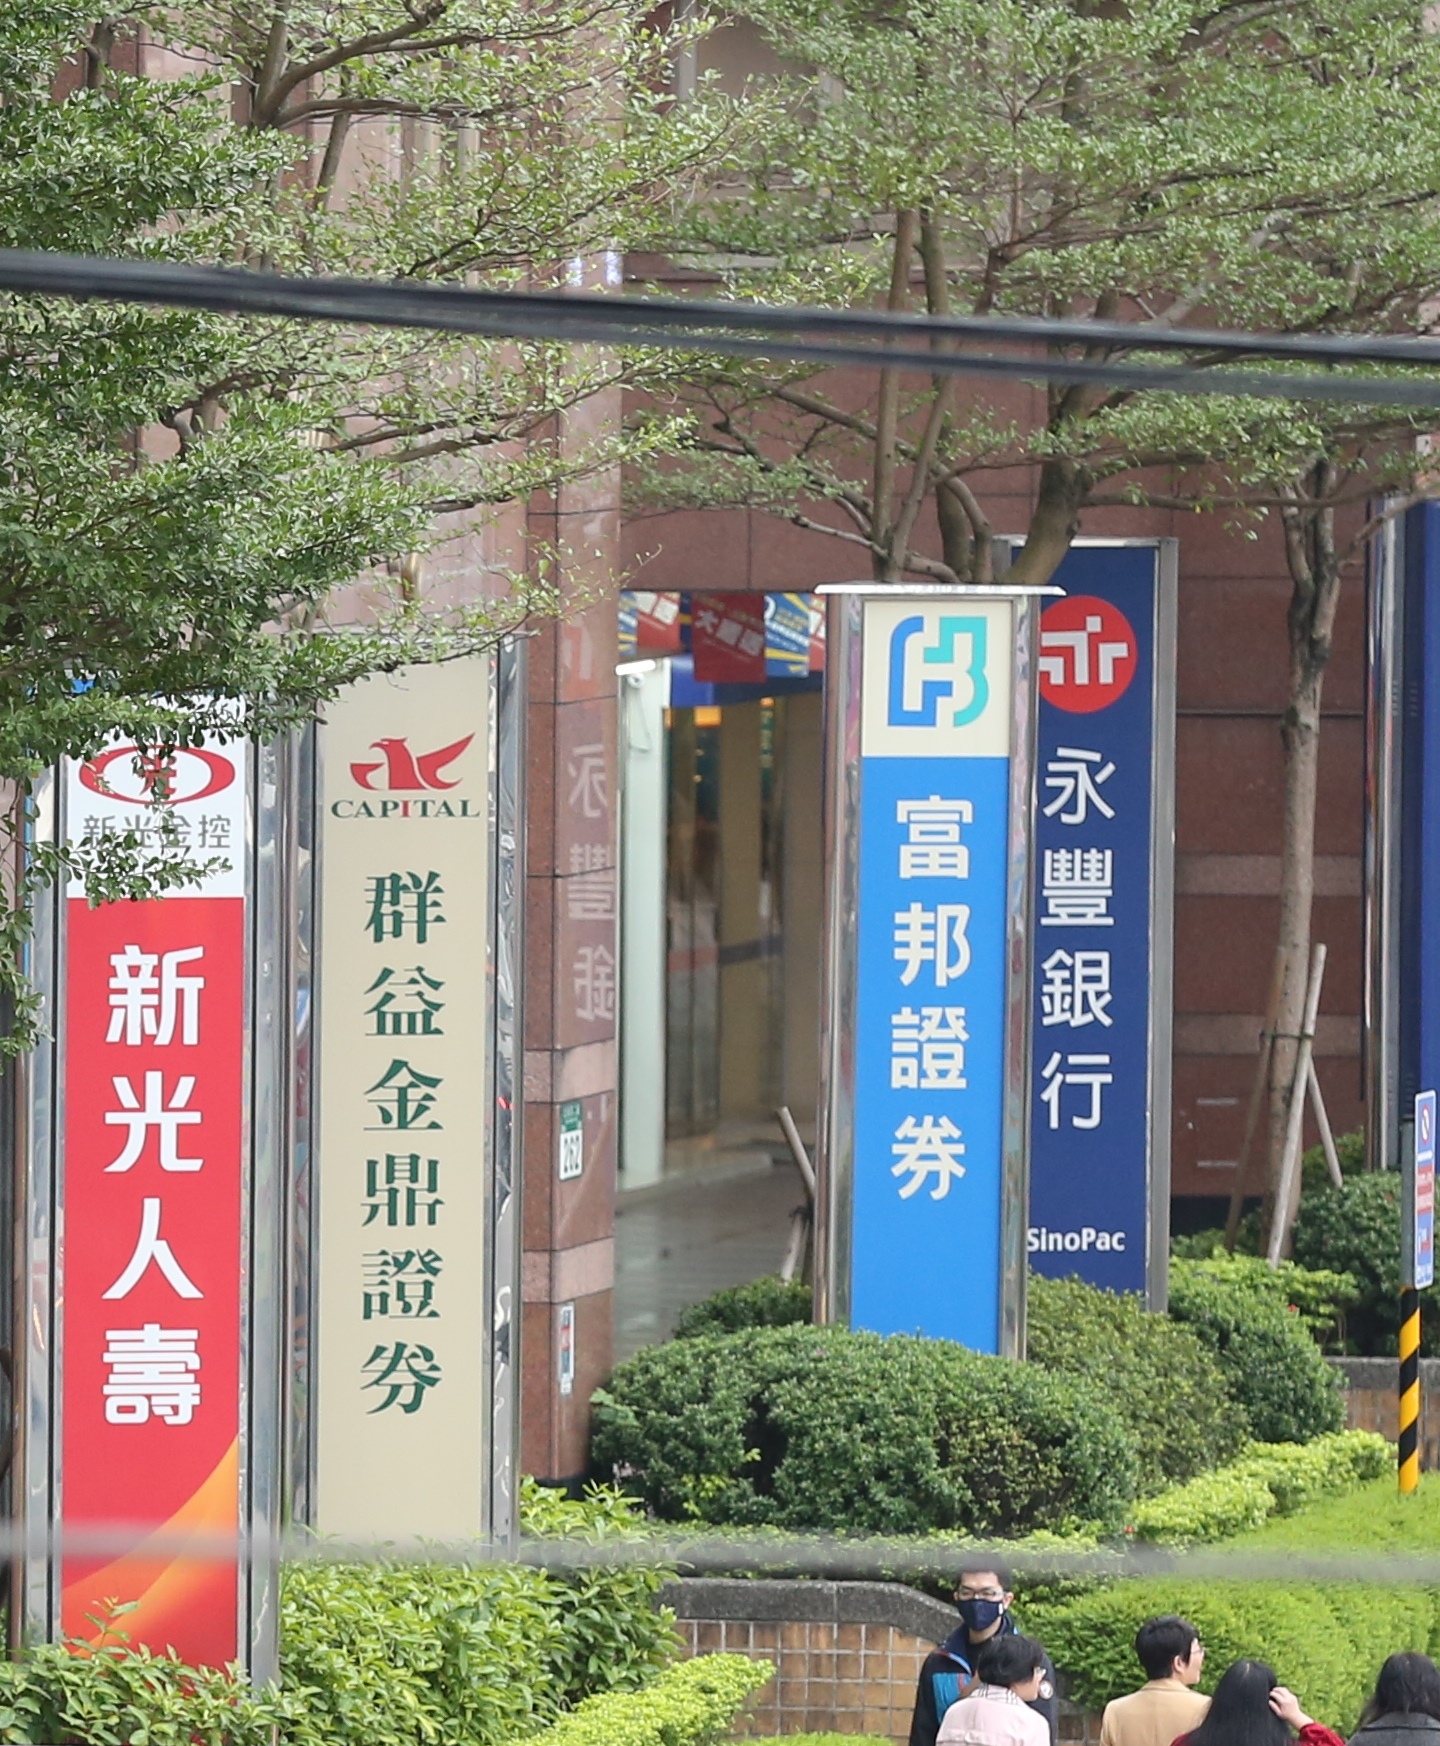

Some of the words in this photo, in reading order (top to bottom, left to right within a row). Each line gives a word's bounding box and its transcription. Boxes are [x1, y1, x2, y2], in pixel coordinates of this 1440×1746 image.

[82, 814, 232, 850] 新光金控
[330, 798, 481, 820] CAPITAL
[890, 795, 974, 1203] 富邦證券
[1039, 746, 1118, 1130] 永豐銀行
[101, 944, 208, 1426] 新光人壽
[359, 870, 448, 1416] 群益金鼎證券
[1027, 1226, 1126, 1253] SinoPac
